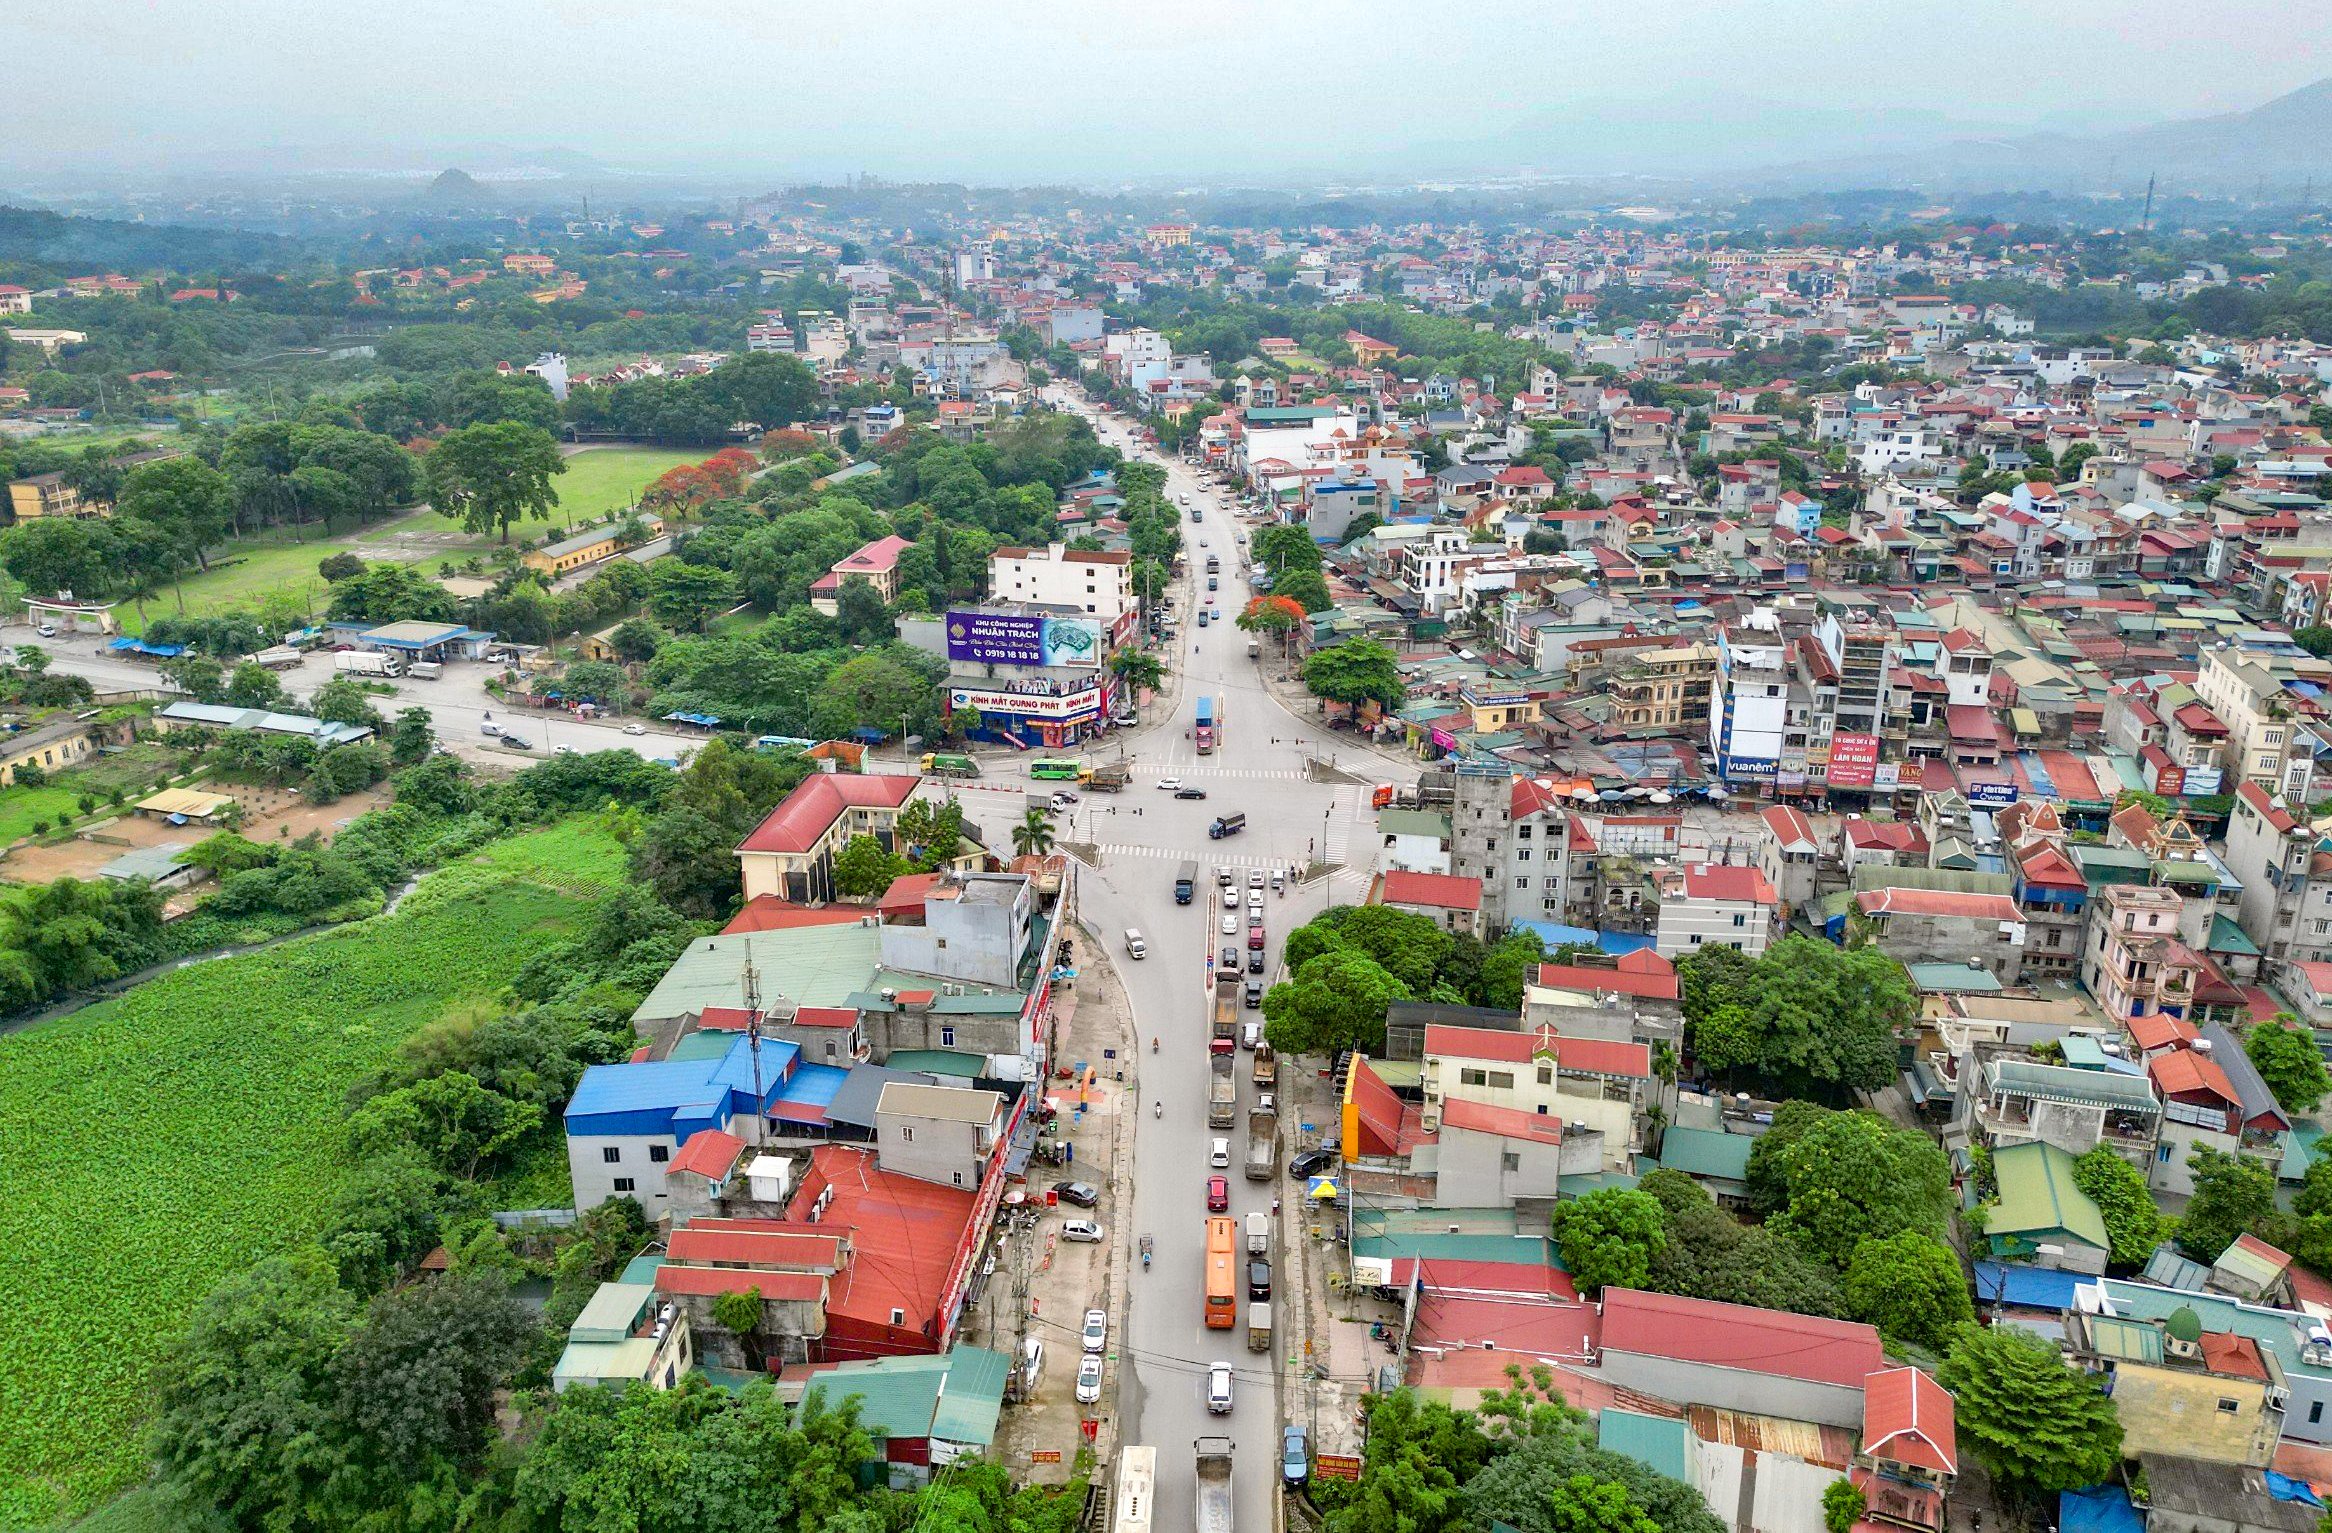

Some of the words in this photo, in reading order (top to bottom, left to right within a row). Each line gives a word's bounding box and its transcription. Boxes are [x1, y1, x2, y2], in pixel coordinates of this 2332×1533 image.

[972, 627, 1005, 638] NHUẬN
[1007, 630, 1039, 639] TRẠCH
[985, 649, 1005, 658] 0919
[971, 695, 989, 704] KÍNH
[991, 695, 1007, 705] MẮT
[1009, 700, 1038, 708] QUANG
[1040, 701, 1060, 710] PHÁT
[1729, 763, 1773, 772] vuanêm
[1980, 793, 2006, 801] Owen
